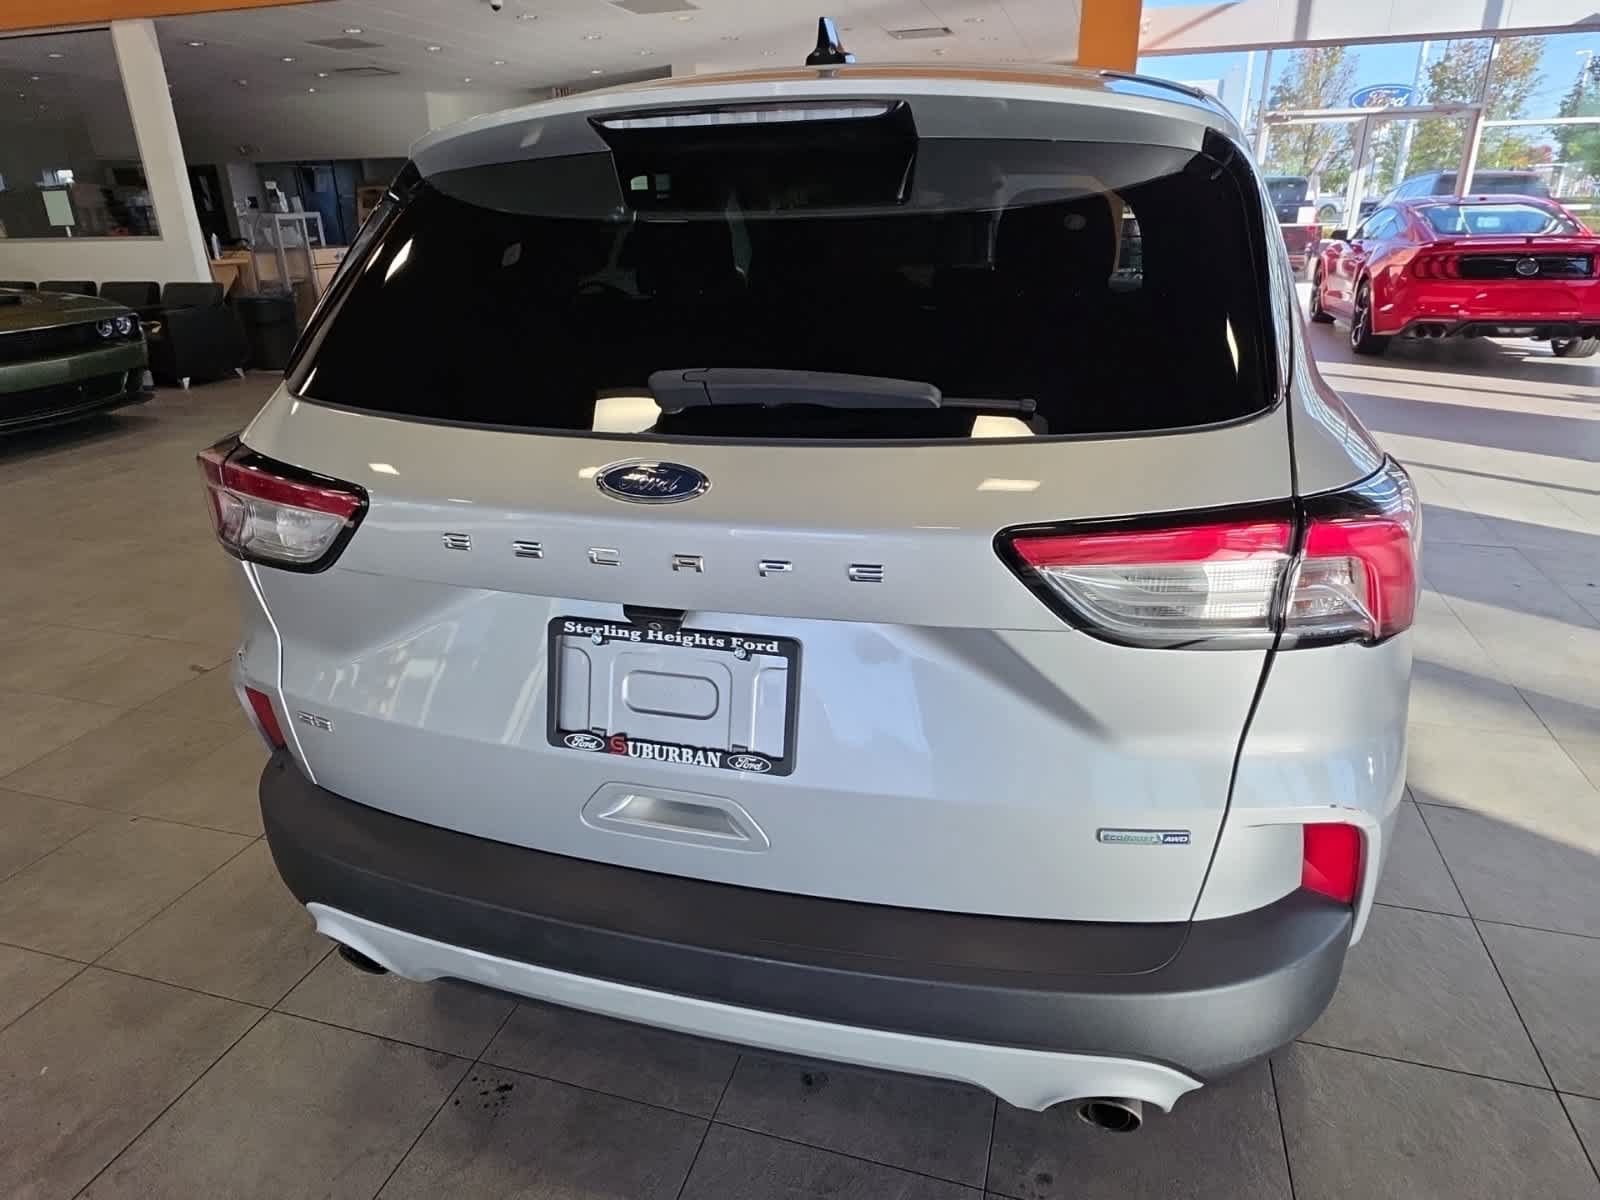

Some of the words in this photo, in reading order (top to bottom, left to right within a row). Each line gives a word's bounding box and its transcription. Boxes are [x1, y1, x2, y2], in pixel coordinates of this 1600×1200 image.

[1364, 90, 1410, 110] Ford
[618, 466, 683, 493] Ford
[442, 532, 885, 583] ESCAPE
[563, 621, 641, 641] Sterling
[647, 629, 725, 648] Heights
[730, 637, 780, 653] Ford
[608, 736, 722, 768] SUBURBAN
[1163, 835, 1188, 843] AWD
